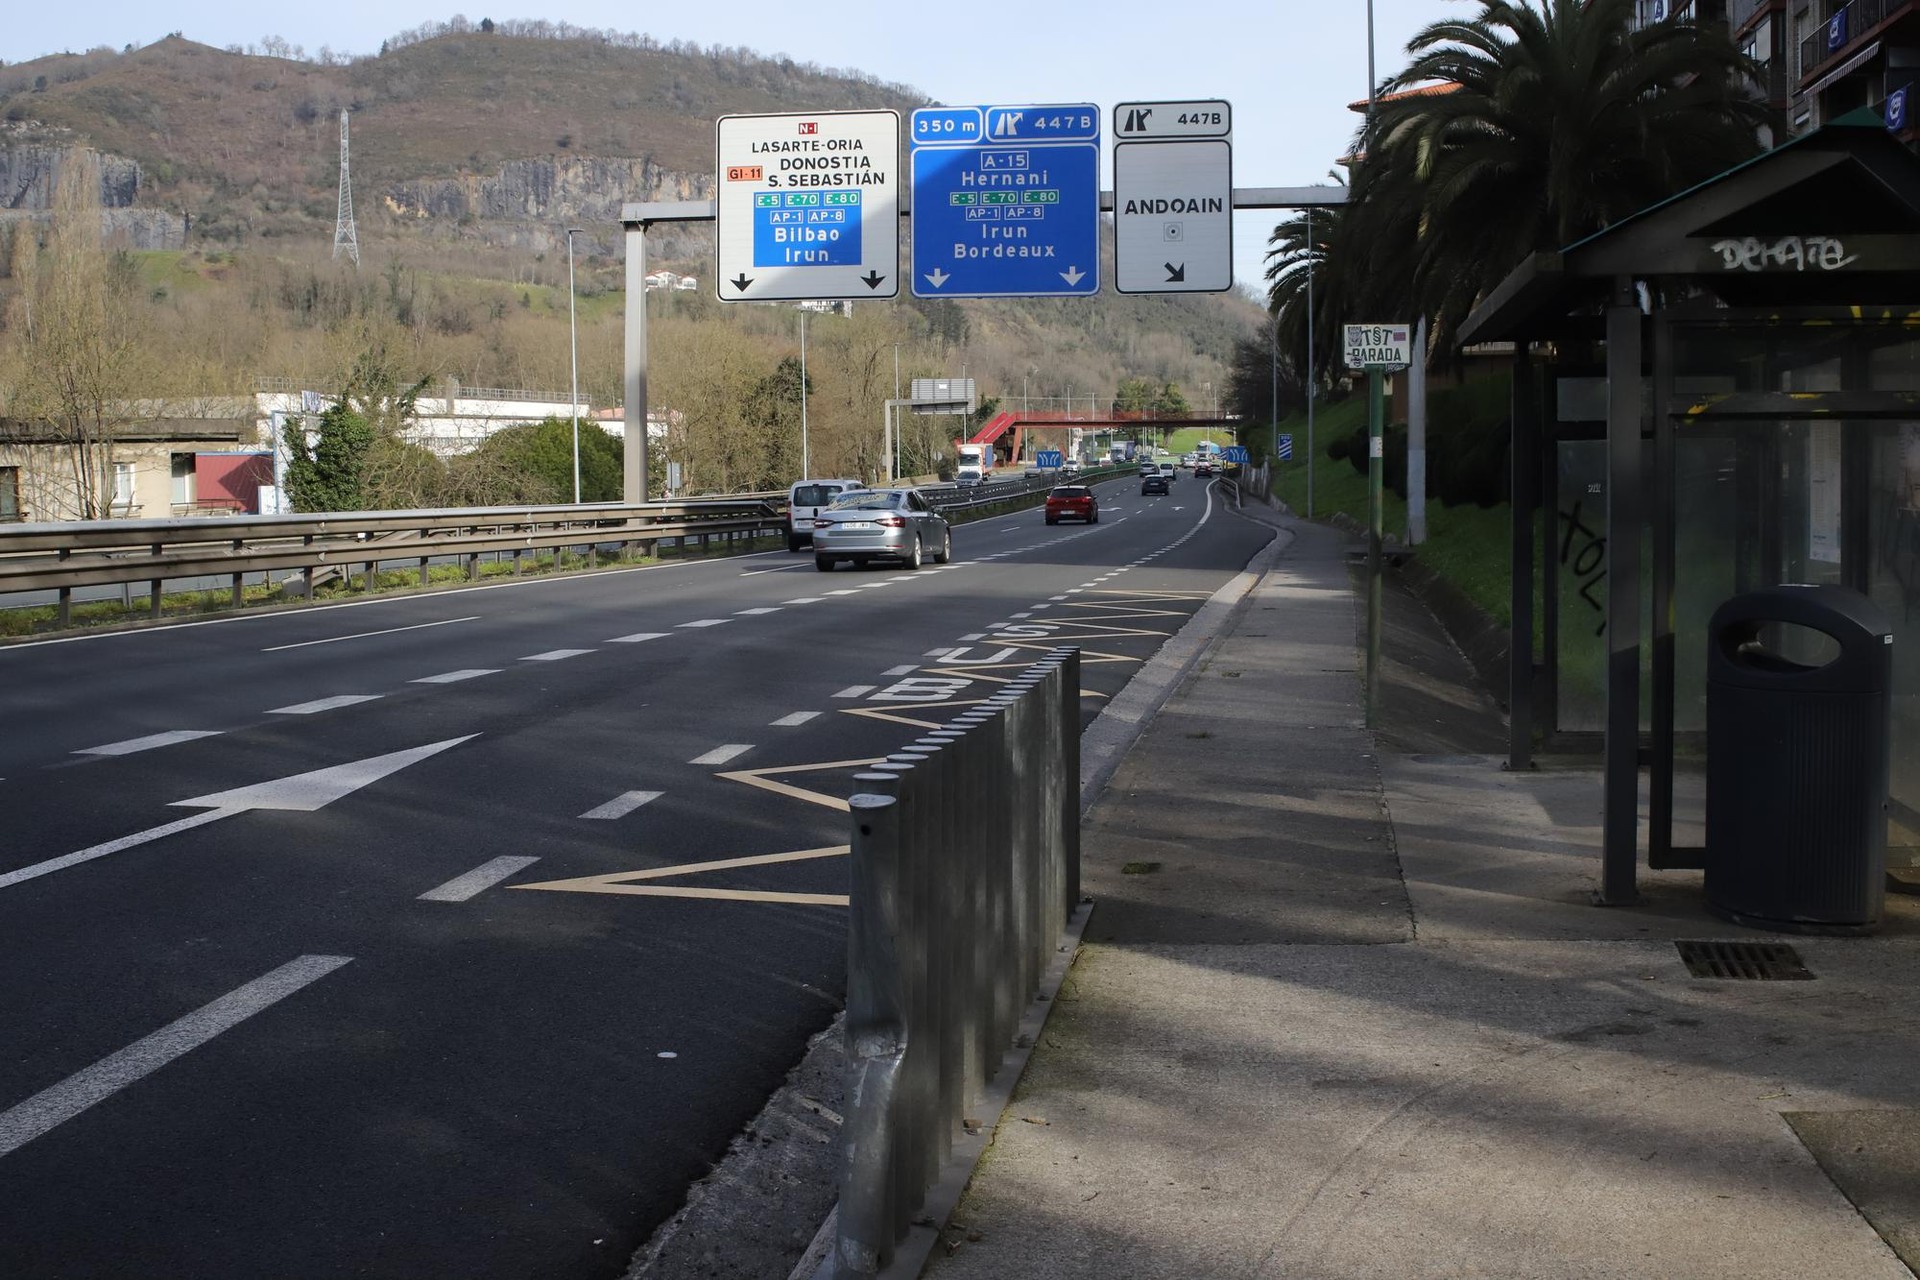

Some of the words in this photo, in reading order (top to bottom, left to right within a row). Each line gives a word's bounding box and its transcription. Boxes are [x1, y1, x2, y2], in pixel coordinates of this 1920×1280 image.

[1178, 113, 1222, 125] 447B
[919, 120, 955, 133] 350
[962, 121, 976, 132] m
[752, 139, 863, 153] LASARTE-ORIA
[780, 156, 871, 171] DONOSTIA
[984, 155, 1026, 168] A-15
[729, 168, 762, 180] GI-11
[768, 174, 782, 188] S.
[788, 170, 885, 187] SEBASTIÁN
[961, 170, 1048, 187] Hernani
[757, 195, 779, 206] E-5
[787, 194, 817, 205] E-70
[825, 192, 857, 204] E-80
[952, 193, 976, 204] E-5
[982, 192, 1016, 203] E-70
[1023, 191, 1056, 202] E-80
[968, 207, 998, 219] AP-1
[1007, 206, 1041, 218] AP-8
[1124, 198, 1223, 215] ANDOAIN
[772, 211, 802, 223] AP-1
[810, 210, 843, 222] AP-8
[775, 226, 840, 243] Bilbao
[981, 223, 1028, 239] Irun
[785, 247, 829, 263] Irun
[954, 243, 1055, 259] Bordeaux
[1352, 347, 1402, 361] PARADA
[866, 624, 1060, 701] BUS
